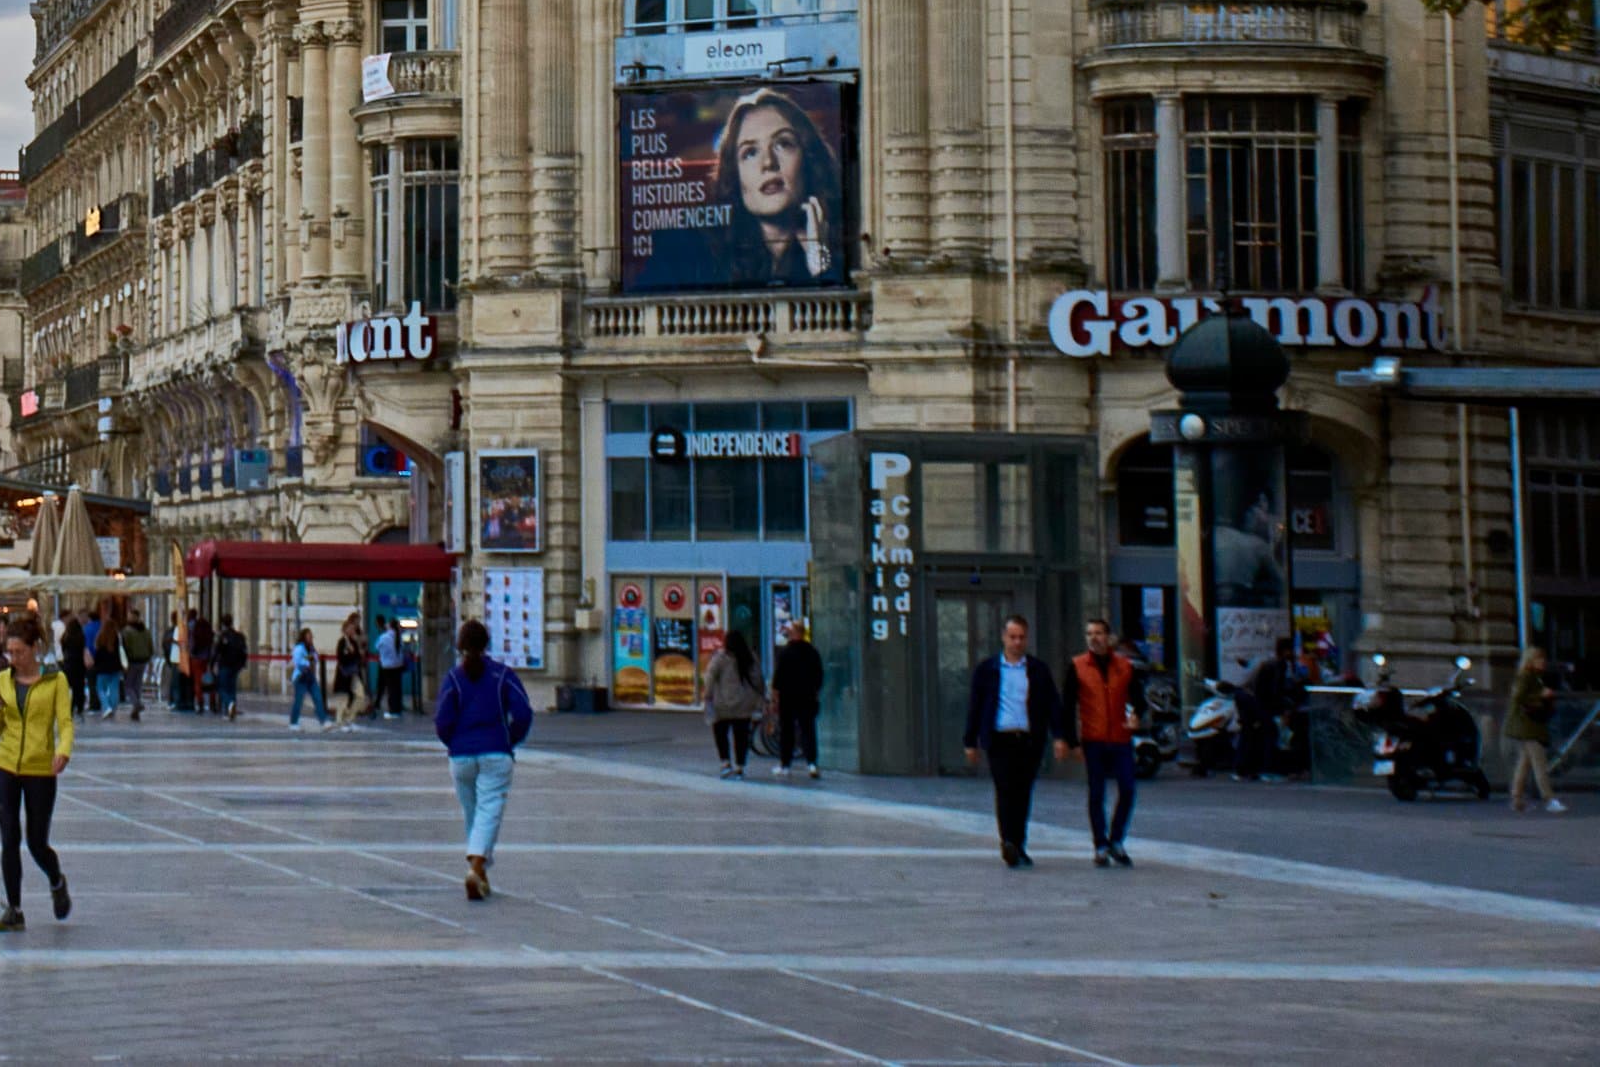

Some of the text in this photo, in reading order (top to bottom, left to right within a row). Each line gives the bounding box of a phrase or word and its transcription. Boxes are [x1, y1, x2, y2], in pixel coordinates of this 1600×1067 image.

[706, 38, 763, 58] eleom
[631, 109, 656, 130] LES
[631, 134, 668, 156] PLUS
[632, 157, 683, 180] BELLES
[632, 182, 706, 205] HISTOIRES
[632, 204, 732, 231] COMMENCENT
[633, 235, 653, 256] ICI
[686, 431, 790, 456] INDEPENDENCE
[870, 452, 911, 640] Parking
